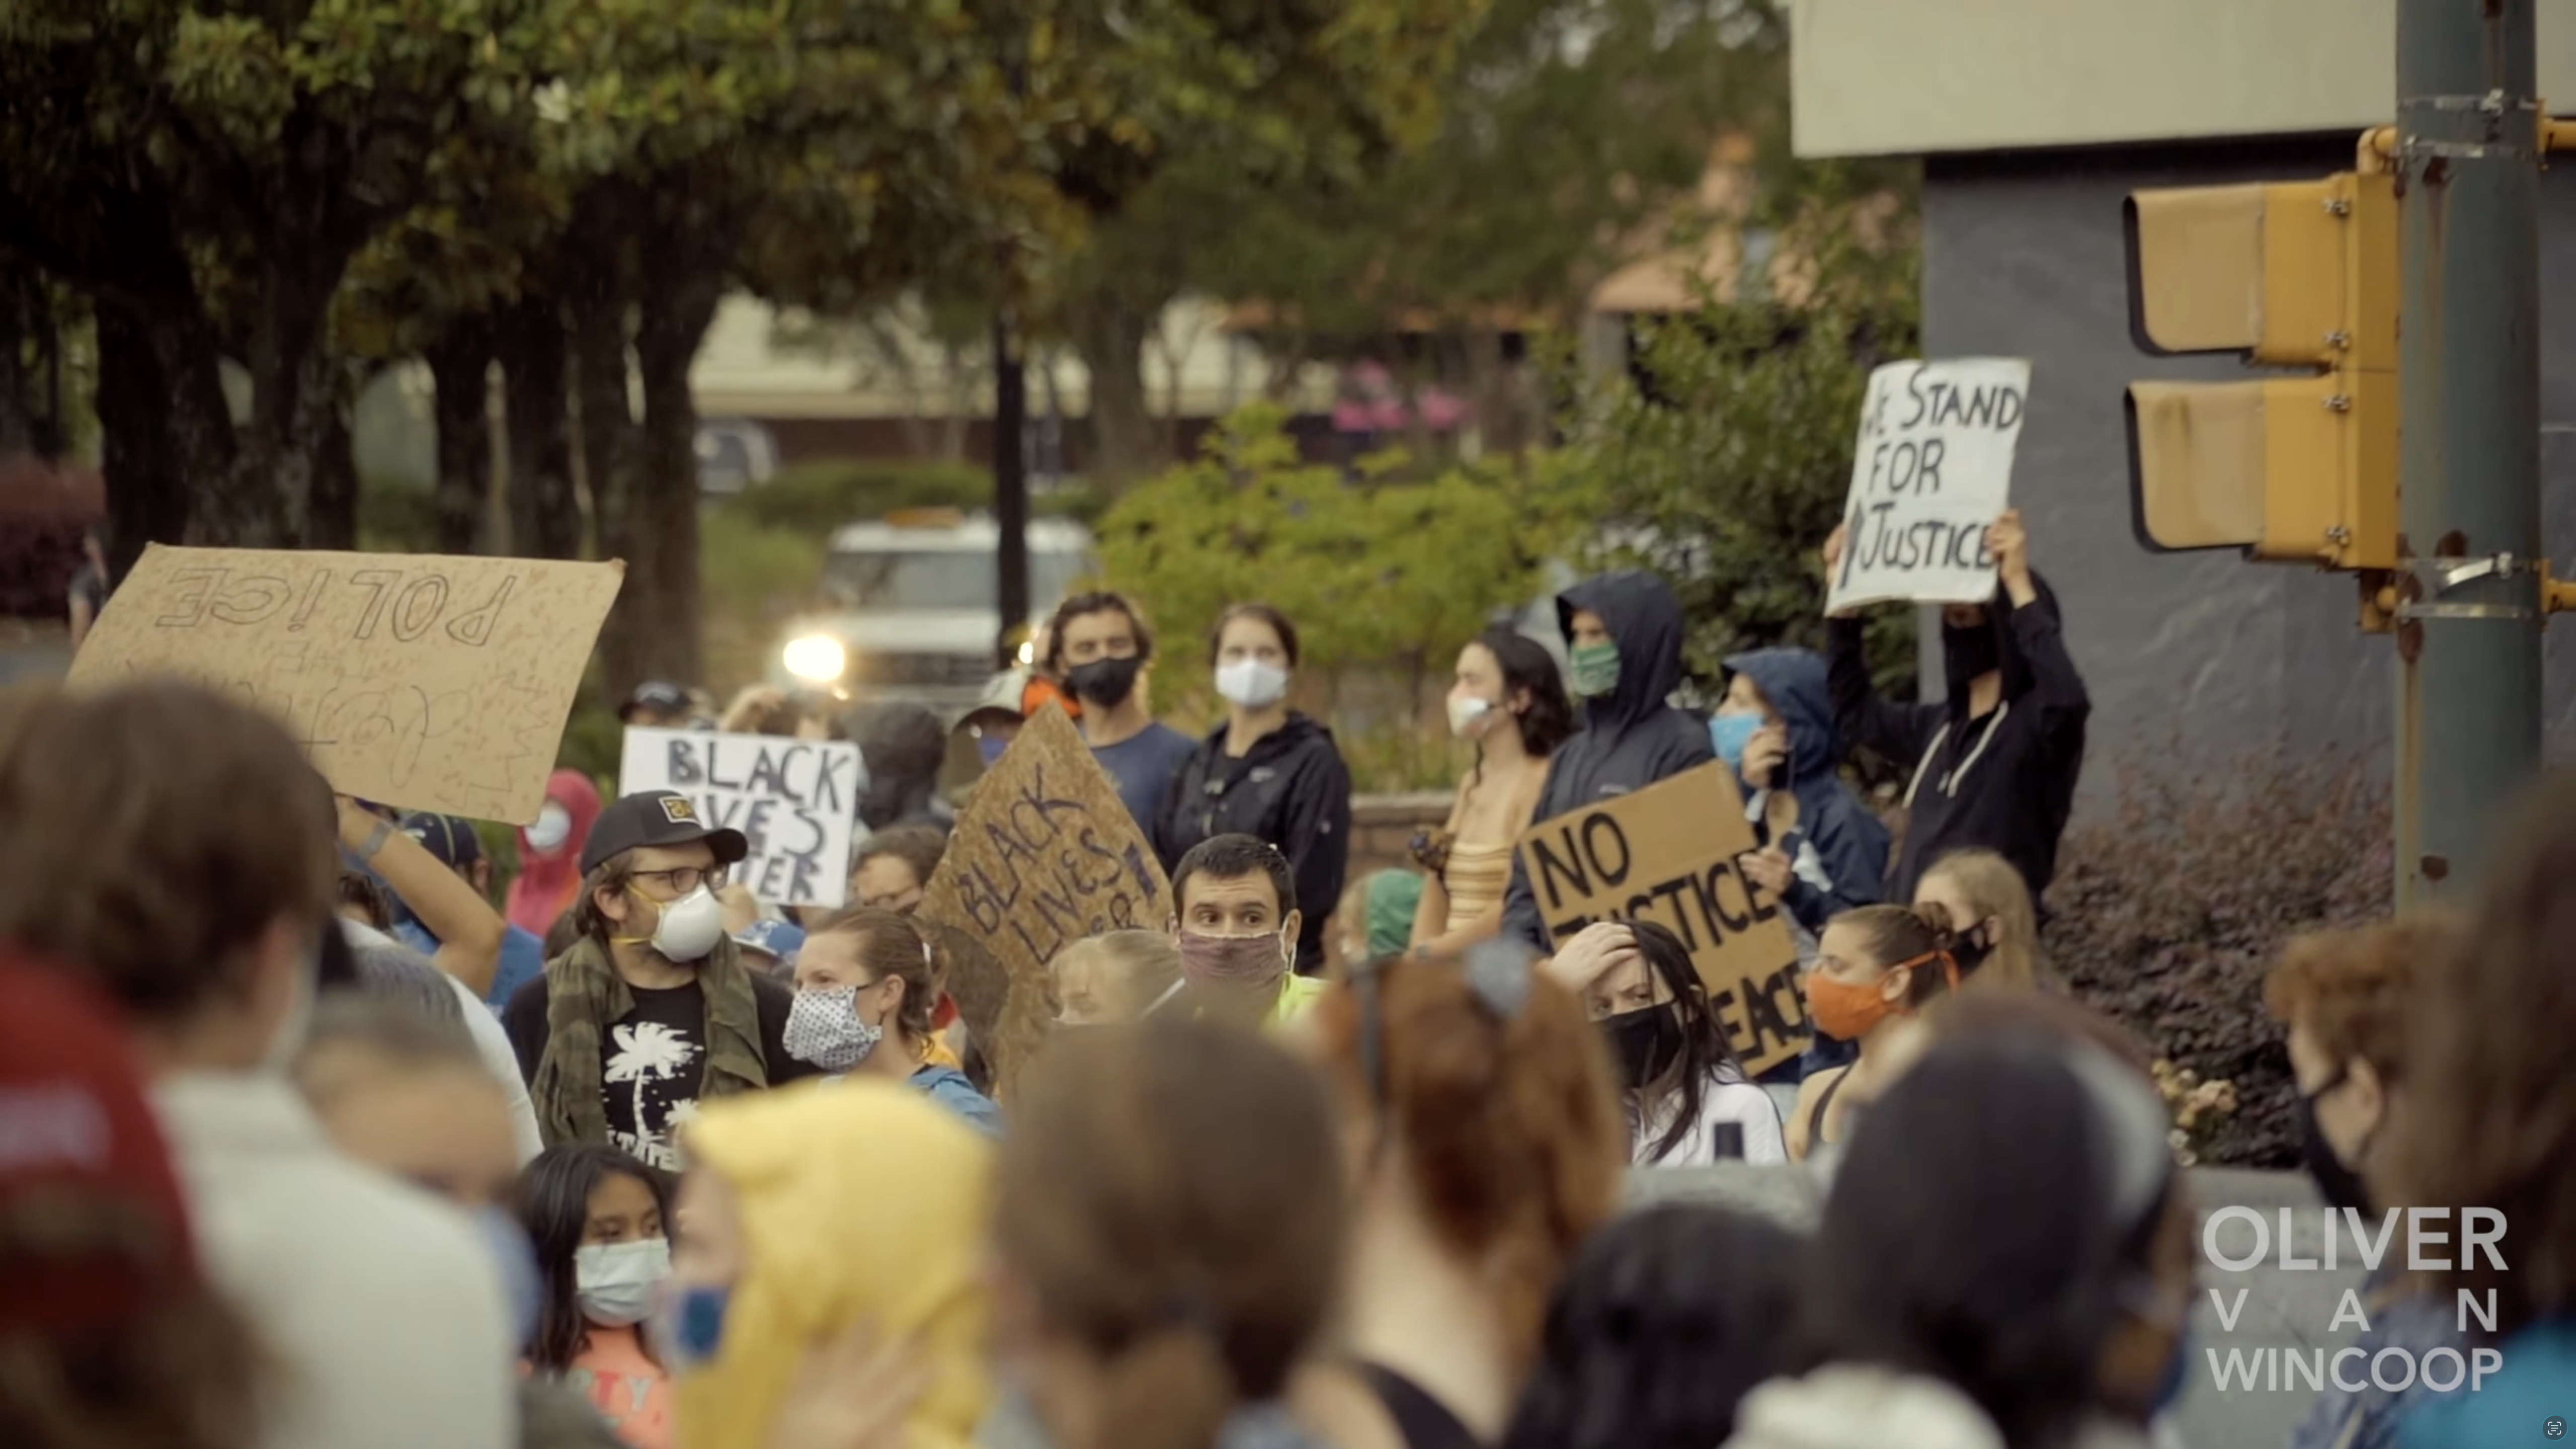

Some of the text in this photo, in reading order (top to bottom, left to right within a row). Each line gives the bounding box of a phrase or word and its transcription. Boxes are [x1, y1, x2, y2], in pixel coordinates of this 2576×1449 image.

[1900, 364, 2022, 432] STAND
[1869, 437, 1945, 496] FOR
[1860, 501, 1997, 571] JUSTICE
[668, 740, 852, 814] BLACK
[689, 794, 827, 857] VES
[955, 762, 1086, 935] BLACK
[1530, 812, 1630, 910] NO
[1011, 827, 1122, 965] LIVES
[1553, 848, 1776, 953] TICE
[1711, 960, 1813, 1060] EACE
